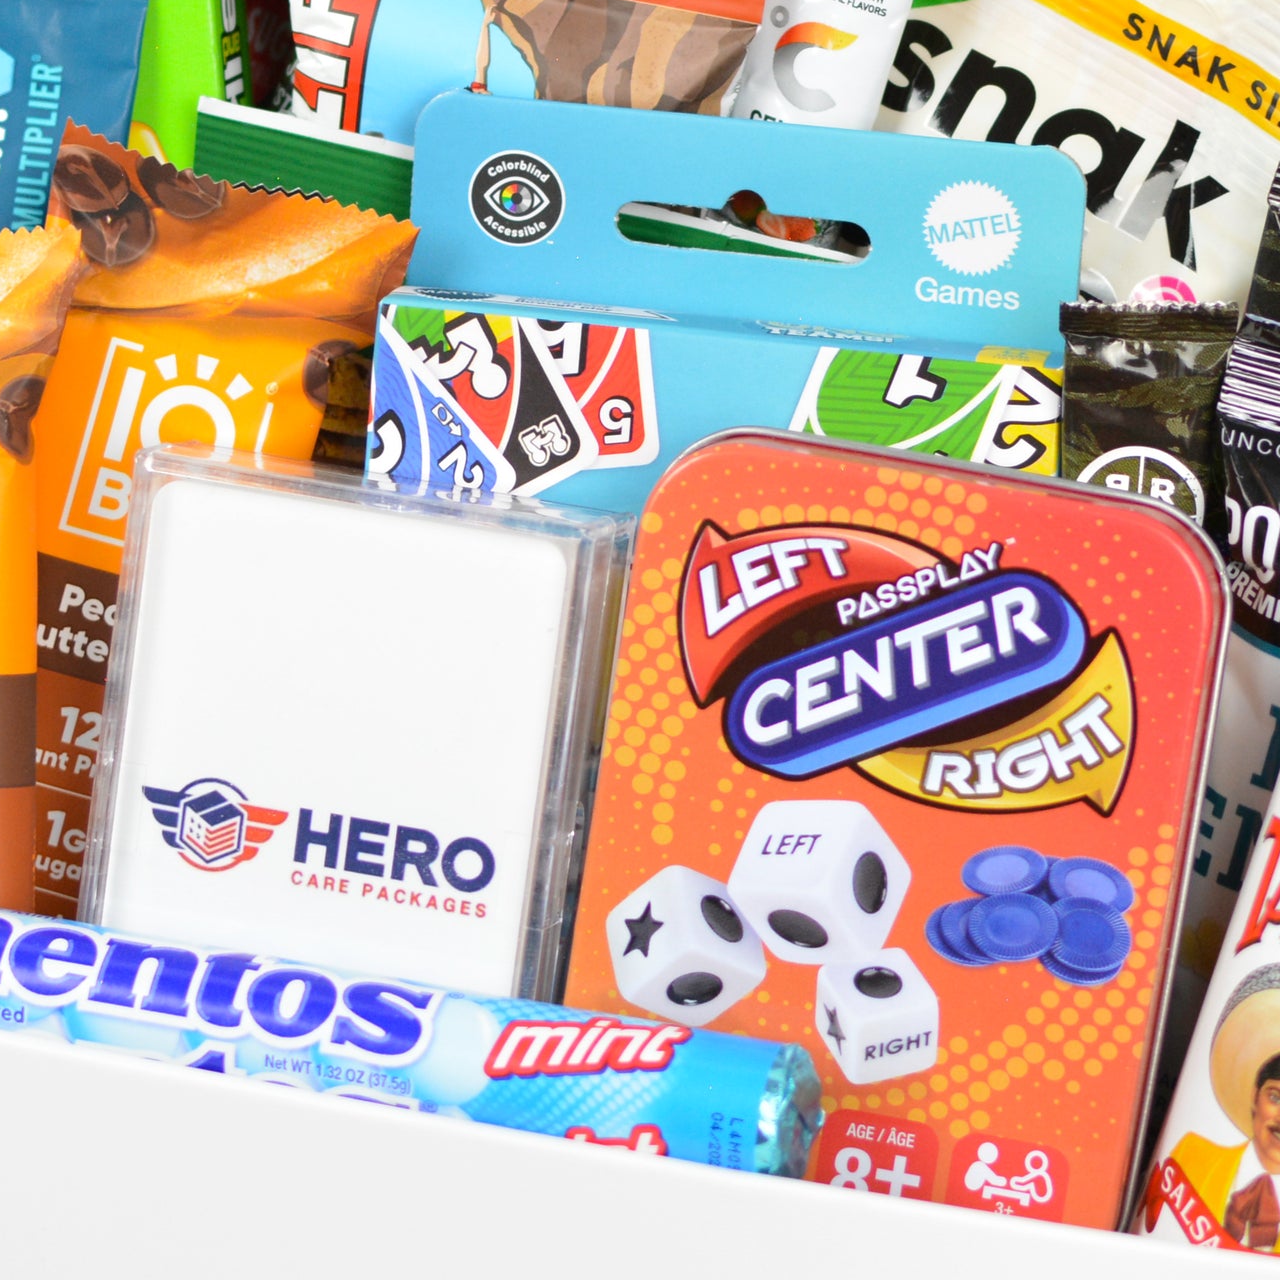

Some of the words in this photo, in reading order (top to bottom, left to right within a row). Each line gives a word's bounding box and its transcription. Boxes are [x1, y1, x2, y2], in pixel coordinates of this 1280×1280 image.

[1123, 11, 1237, 93] SNAK
[880, 17, 1231, 273] snak
[487, 160, 551, 183] Colorblind
[483, 215, 548, 238] Accessible
[927, 211, 1022, 246] MATTEL
[914, 276, 1020, 313] Games
[697, 536, 848, 638] LEFT
[836, 541, 1006, 626] PASSPLAY
[741, 586, 1054, 749] CENTER
[922, 693, 1129, 798] RIGHT
[292, 807, 496, 894] HERO
[762, 833, 823, 857] LEFT
[291, 870, 350, 896] CARE
[361, 881, 488, 919] PACKAGES
[489, 1018, 690, 1072] mint
[863, 1030, 933, 1063] RIGHT
[263, 1052, 289, 1073] Net
[290, 1056, 313, 1076] WT
[315, 1060, 345, 1081] 1.32
[346, 1066, 365, 1085] OZ
[368, 1069, 412, 1096] (37.5g)
[845, 1122, 876, 1141] AGE
[886, 1126, 916, 1149] ÂGE
[829, 1146, 922, 1198] 8+
